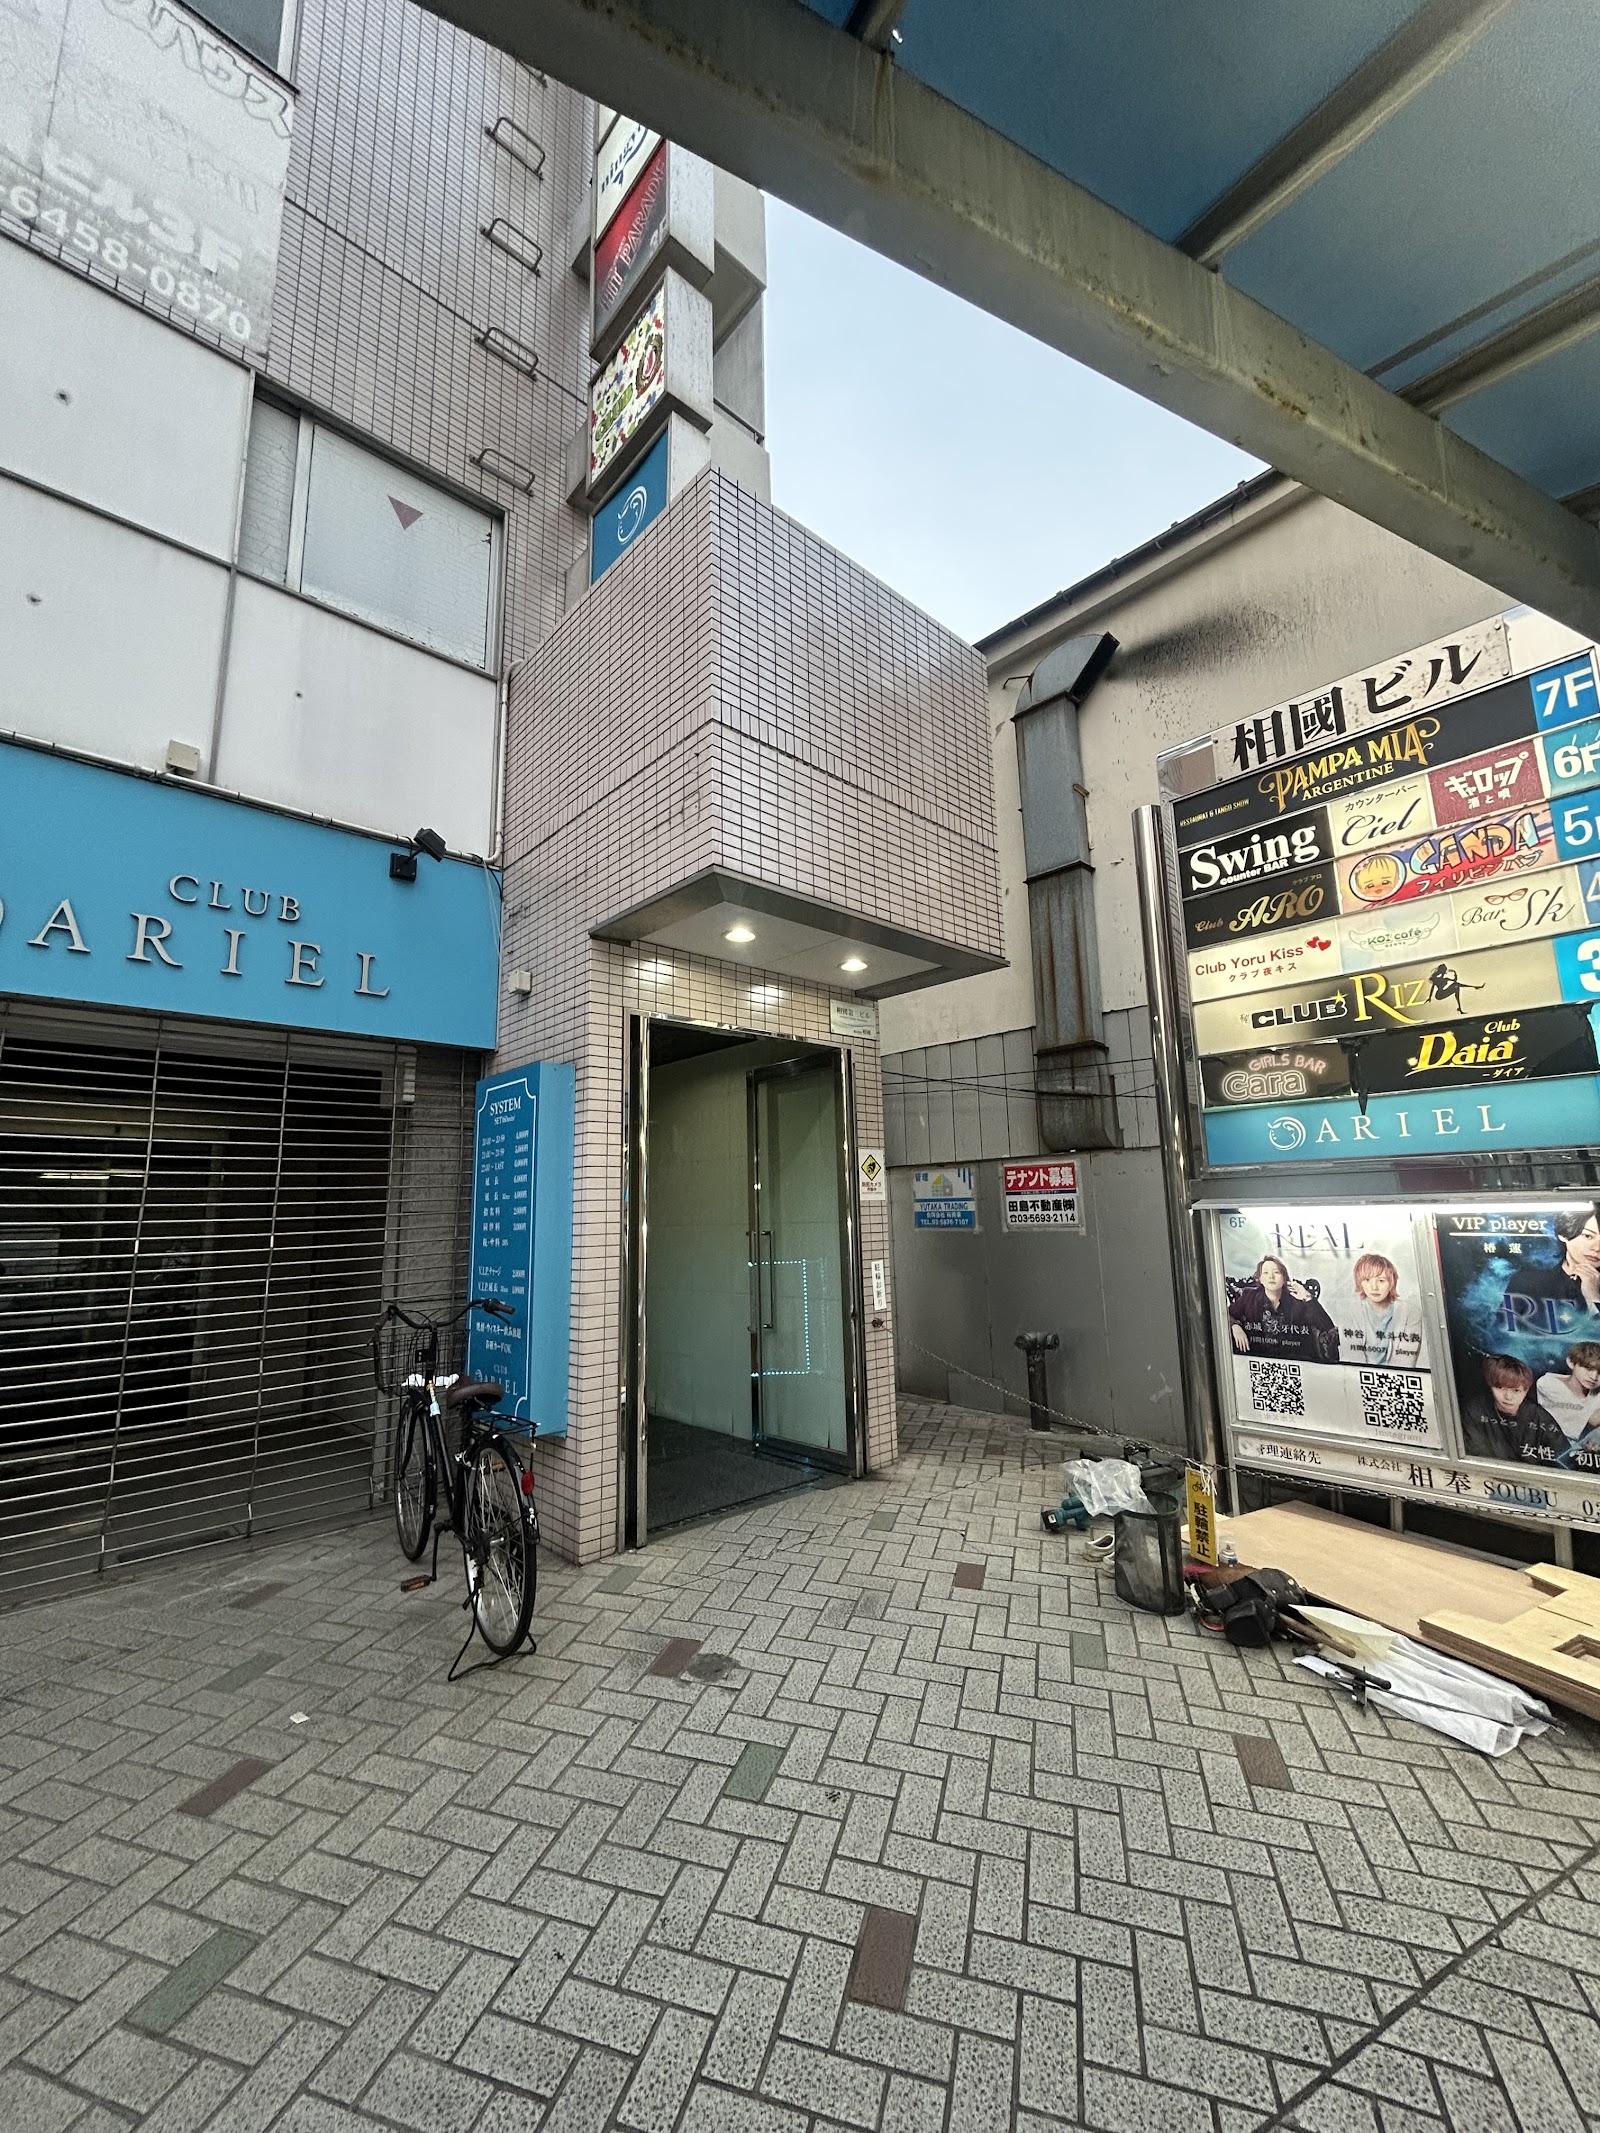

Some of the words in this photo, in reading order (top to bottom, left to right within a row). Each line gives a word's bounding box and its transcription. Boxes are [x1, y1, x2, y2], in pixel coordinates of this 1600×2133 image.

[1233, 645, 1482, 771] 相國ビル
[1536, 667, 1594, 717] 7F
[1258, 746, 1363, 813] PAMPA
[1367, 716, 1441, 766] MIA
[1553, 740, 1600, 779] 6F
[1302, 762, 1395, 801] ARGENTINE
[1344, 783, 1418, 813] カウンターバー
[1341, 797, 1421, 847] Ciel
[1563, 805, 1600, 846] 5
[1190, 825, 1321, 891] Swing
[1409, 812, 1541, 875] GANDA
[1220, 867, 1262, 886] counter
[1263, 858, 1289, 874] BAR
[169, 874, 301, 922] CLUB
[1194, 917, 1224, 932] Club
[1228, 884, 1325, 932] ARO
[1461, 906, 1507, 927] Bar
[27, 898, 391, 998] ARIEL
[1367, 933, 1391, 946] KOI
[1195, 961, 1227, 976] Club
[1231, 954, 1266, 969] Yoru
[1270, 946, 1304, 962] Kiss
[1228, 962, 1297, 983] クラブ夜キス
[1251, 996, 1348, 1029] CLUB
[1349, 972, 1427, 1025] RIZ
[1484, 1018, 1521, 1034] Club
[1248, 1054, 1290, 1071] GIRLS
[1294, 1054, 1327, 1074] BAR
[1411, 1032, 1516, 1071] Daia
[490, 1096, 521, 1116] SYSTEM
[1315, 1105, 1506, 1143] ARIEL
[1006, 1166, 1074, 1188] テナント募集
[920, 1203, 942, 1211] YUTAKA
[943, 1202, 969, 1211] TRADING
[1229, 1216, 1247, 1229] 6F
[1452, 1216, 1486, 1230] VIP
[1490, 1216, 1549, 1233] player
[1343, 1328, 1365, 1339] 神谷
[1374, 1428, 1422, 1442] Instagram
[1520, 1443, 1556, 1462] 女性
[1575, 1451, 1600, 1468] 初
[1356, 1455, 1403, 1473] 株式会社
[1483, 1479, 1558, 1508] SOUBU
[1193, 1501, 1211, 1559] 駐輪禁止
